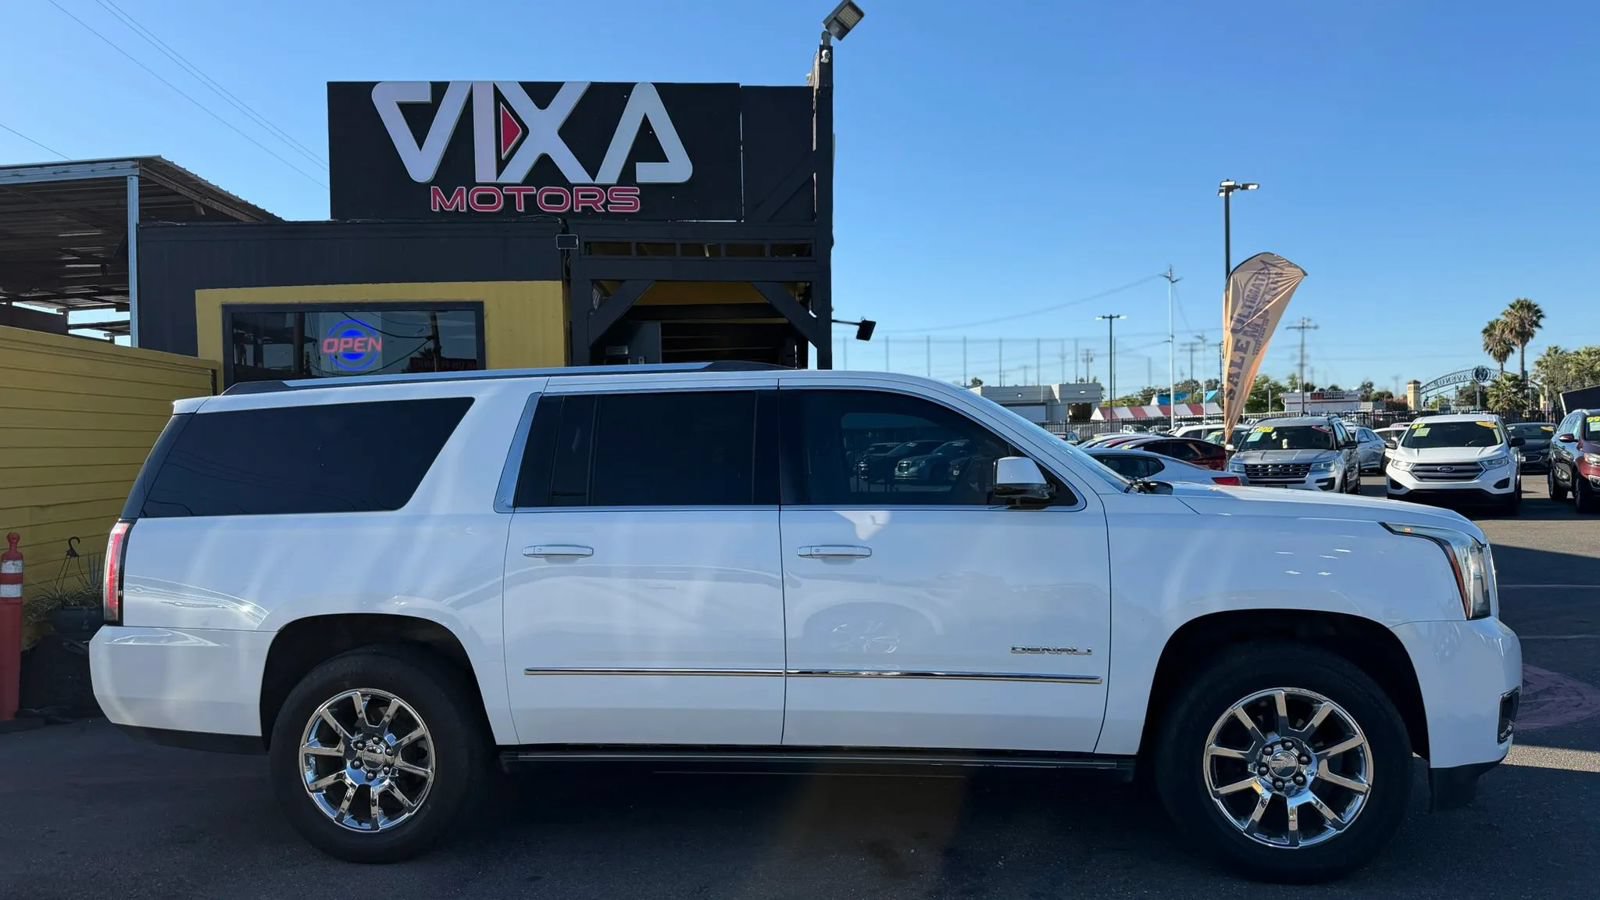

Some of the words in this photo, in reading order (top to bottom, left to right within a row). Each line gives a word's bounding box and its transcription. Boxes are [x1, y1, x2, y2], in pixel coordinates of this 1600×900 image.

[372, 81, 693, 184] VIXA
[430, 186, 642, 213] MOTORS
[322, 337, 384, 354] OPEN
[1226, 338, 1251, 401] SALE
[1010, 645, 1093, 656] DENALI
